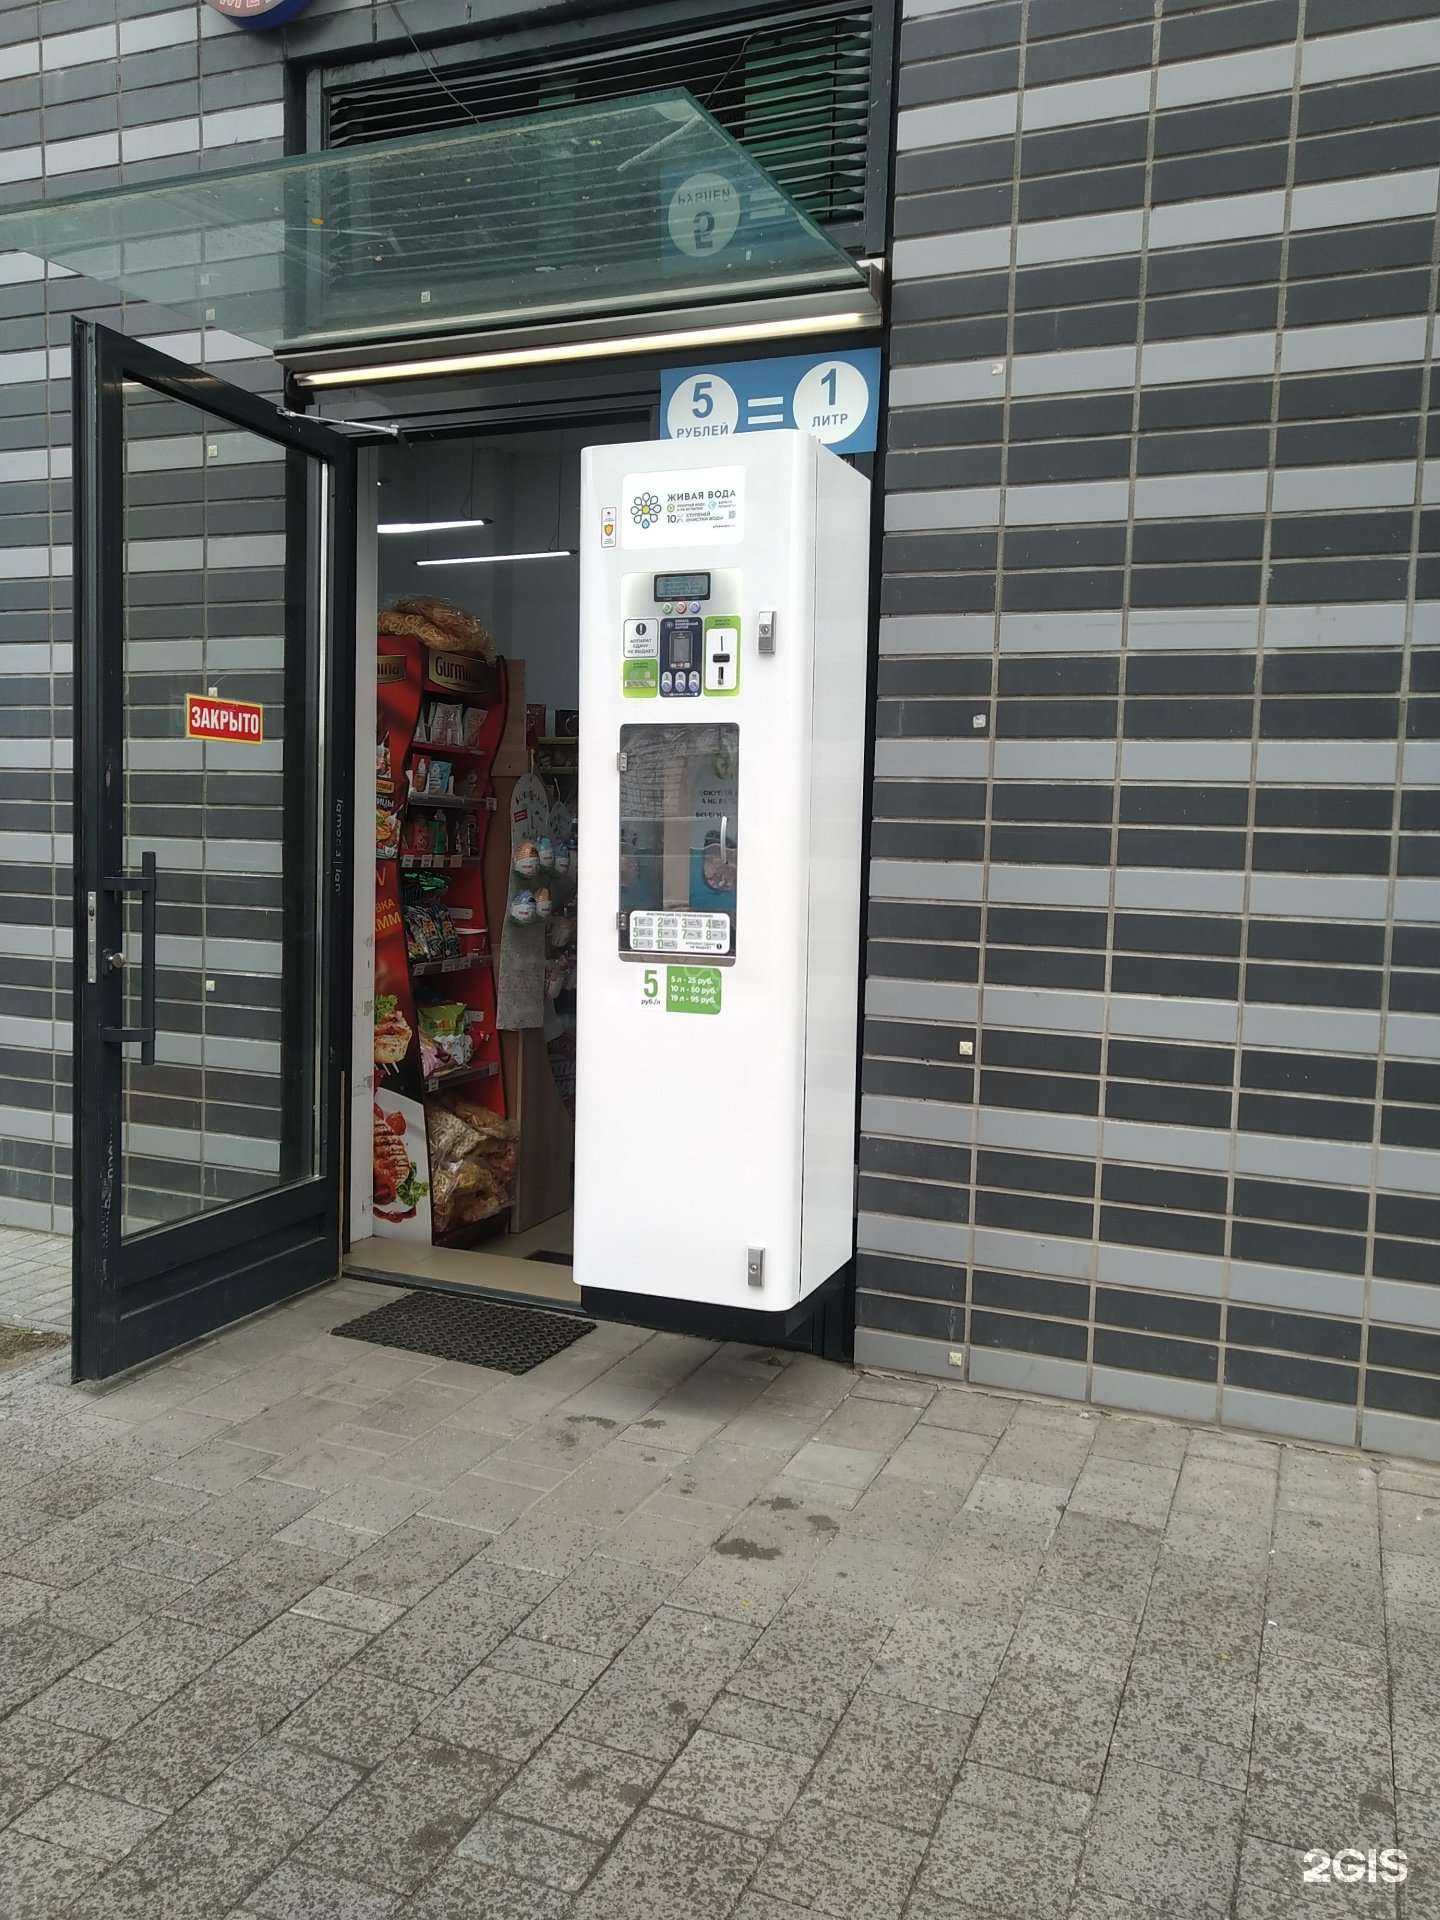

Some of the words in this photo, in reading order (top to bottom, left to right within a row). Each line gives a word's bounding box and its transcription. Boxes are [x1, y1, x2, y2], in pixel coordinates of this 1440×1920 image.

[820, 367, 837, 406] 1
[691, 380, 714, 419] 5
[676, 422, 729, 439] РУБЛЕЙ
[811, 412, 849, 428] ЛИТР
[667, 491, 704, 502] ЖИВАЯ
[707, 489, 736, 500] ВОДА
[191, 706, 259, 735] ЗАКРЫТО
[657, 917, 664, 928] 2
[644, 969, 658, 998] 5
